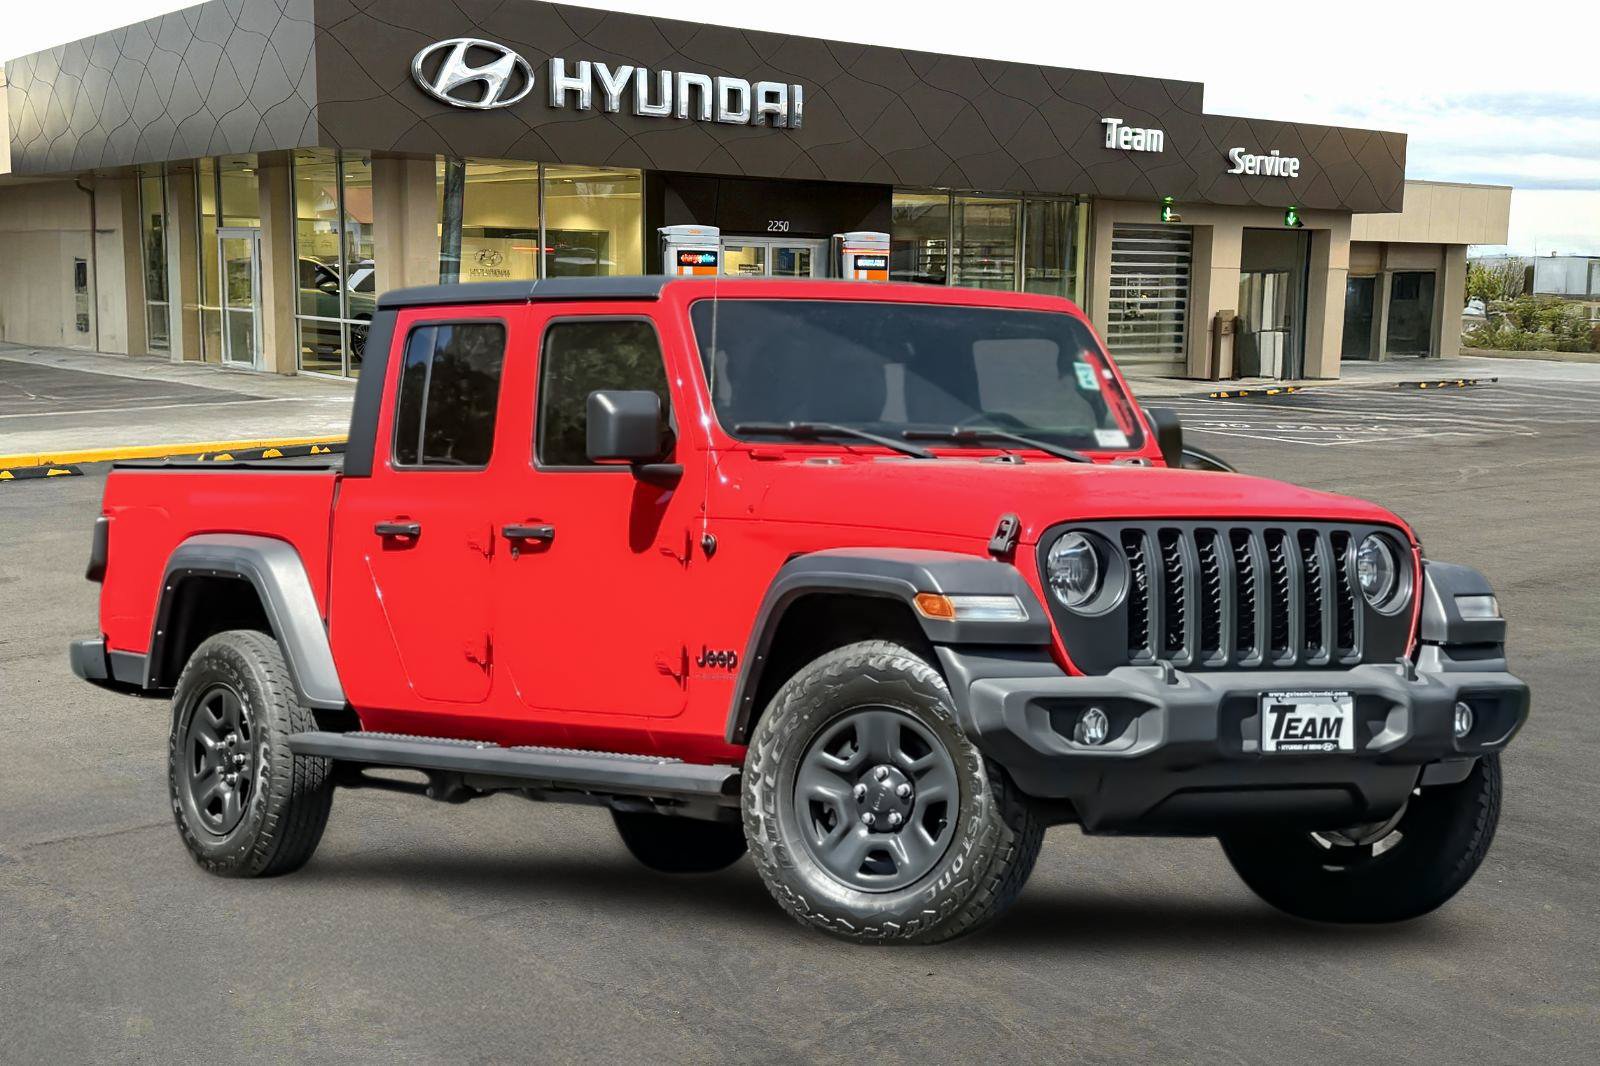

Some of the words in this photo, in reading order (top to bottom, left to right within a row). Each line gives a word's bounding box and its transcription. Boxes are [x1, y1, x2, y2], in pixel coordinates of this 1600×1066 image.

[548, 57, 804, 129] HYUNDAI
[1101, 117, 1164, 153] Team
[1227, 147, 1300, 178] Service
[767, 220, 790, 232] 2250
[696, 645, 738, 673] Jeep
